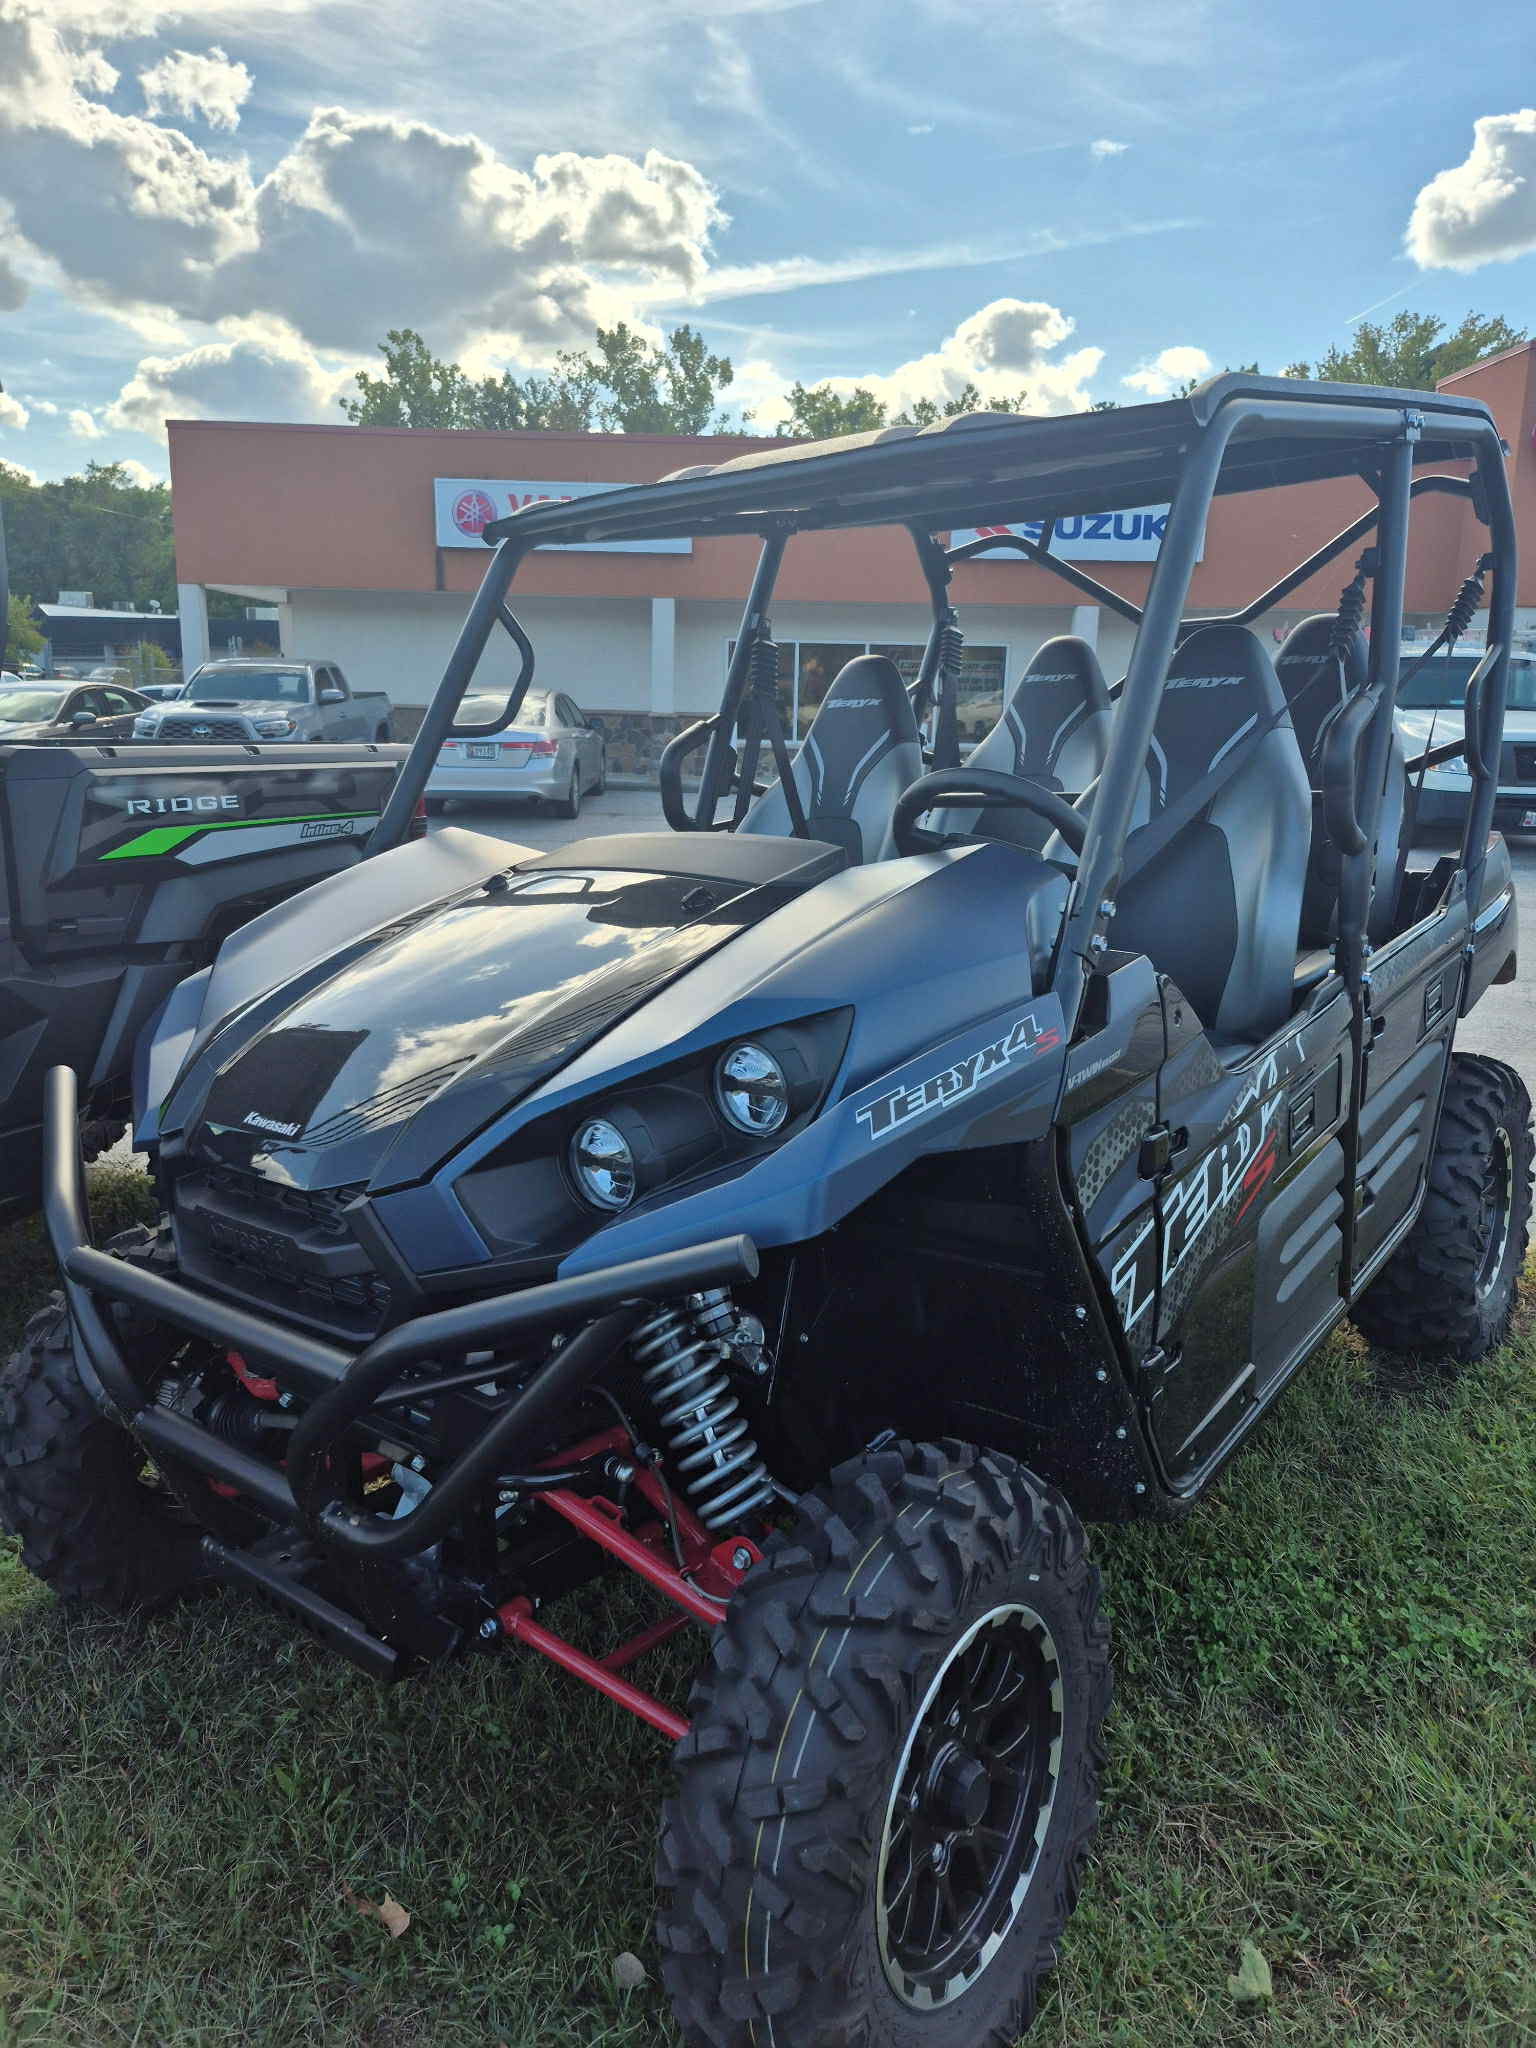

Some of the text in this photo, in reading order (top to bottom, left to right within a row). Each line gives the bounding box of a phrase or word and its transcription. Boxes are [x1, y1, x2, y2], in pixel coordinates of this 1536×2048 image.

[1023, 513, 1169, 540] SUZUK
[1164, 675, 1246, 690] TERYX
[127, 794, 240, 816] RIDGE
[301, 820, 354, 841] Inline-4
[242, 1111, 302, 1137] Kawasaki
